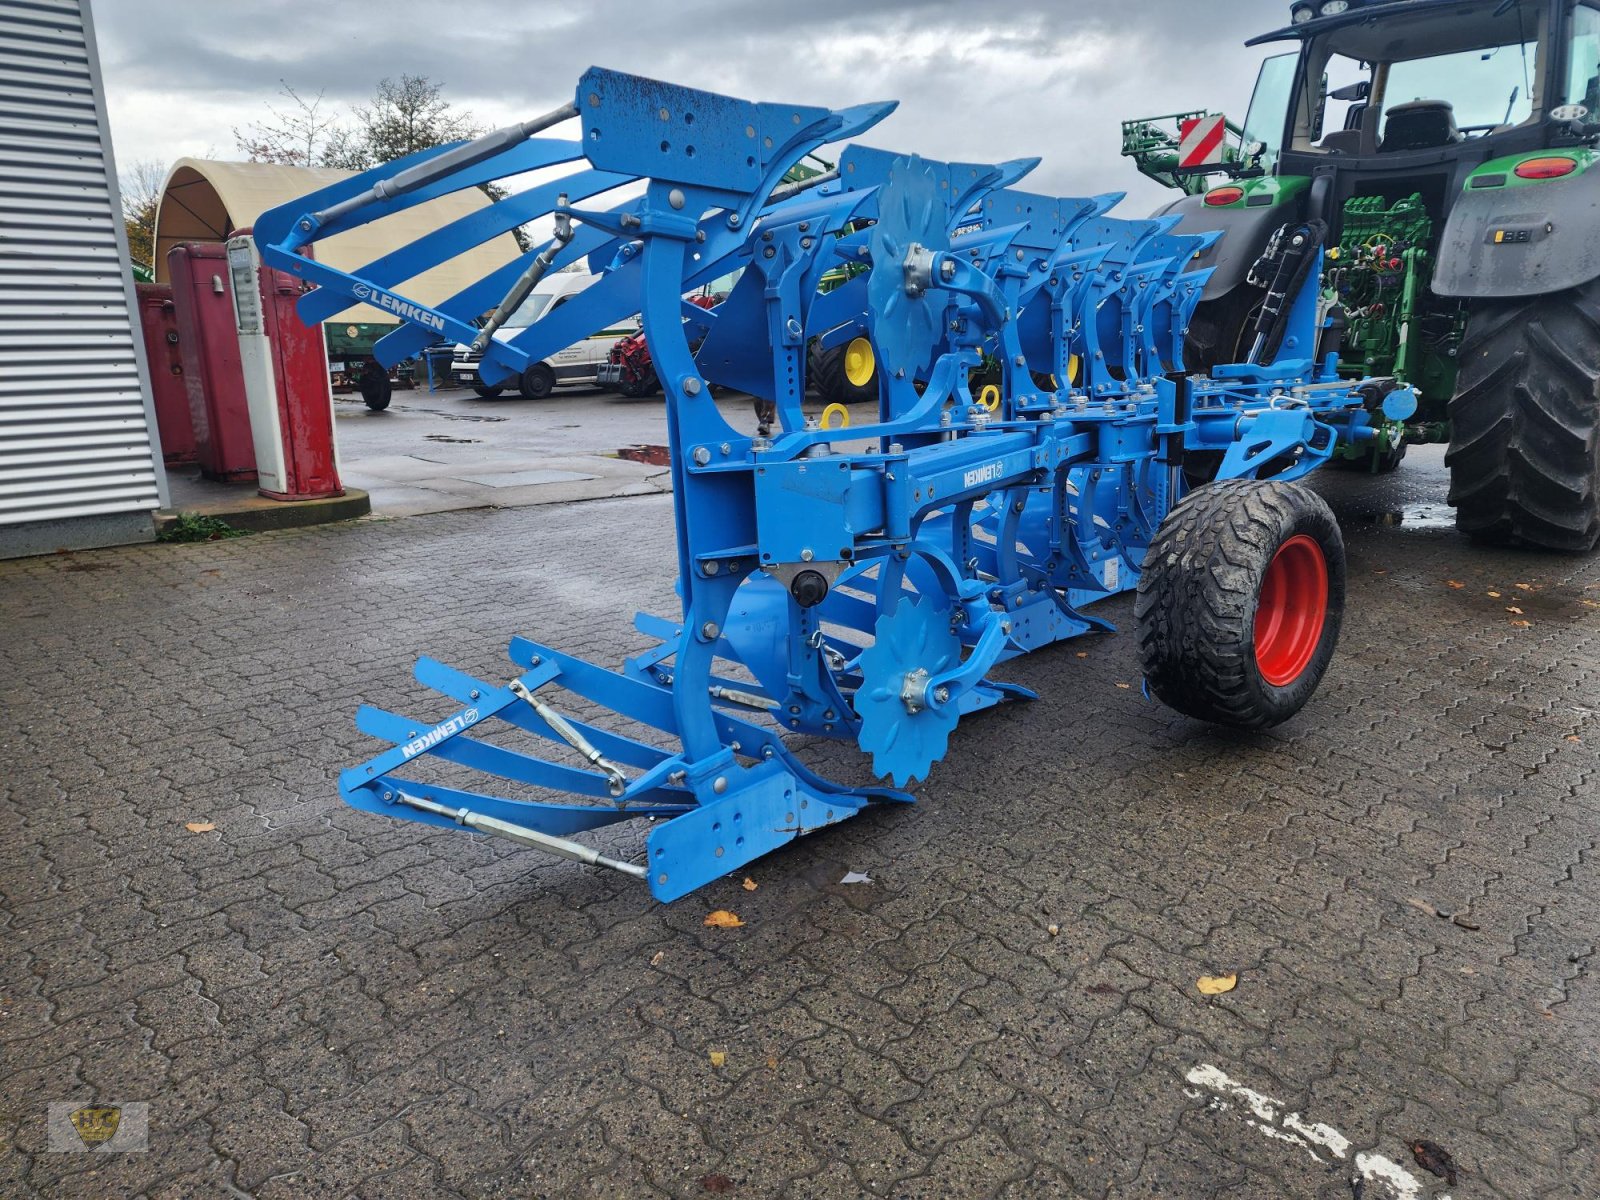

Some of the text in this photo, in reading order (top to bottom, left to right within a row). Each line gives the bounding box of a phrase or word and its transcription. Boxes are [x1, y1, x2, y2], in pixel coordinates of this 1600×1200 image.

[371, 290, 445, 331] LEMKEN
[964, 463, 996, 488] LEMKEN
[402, 716, 465, 758] LEMKEN
